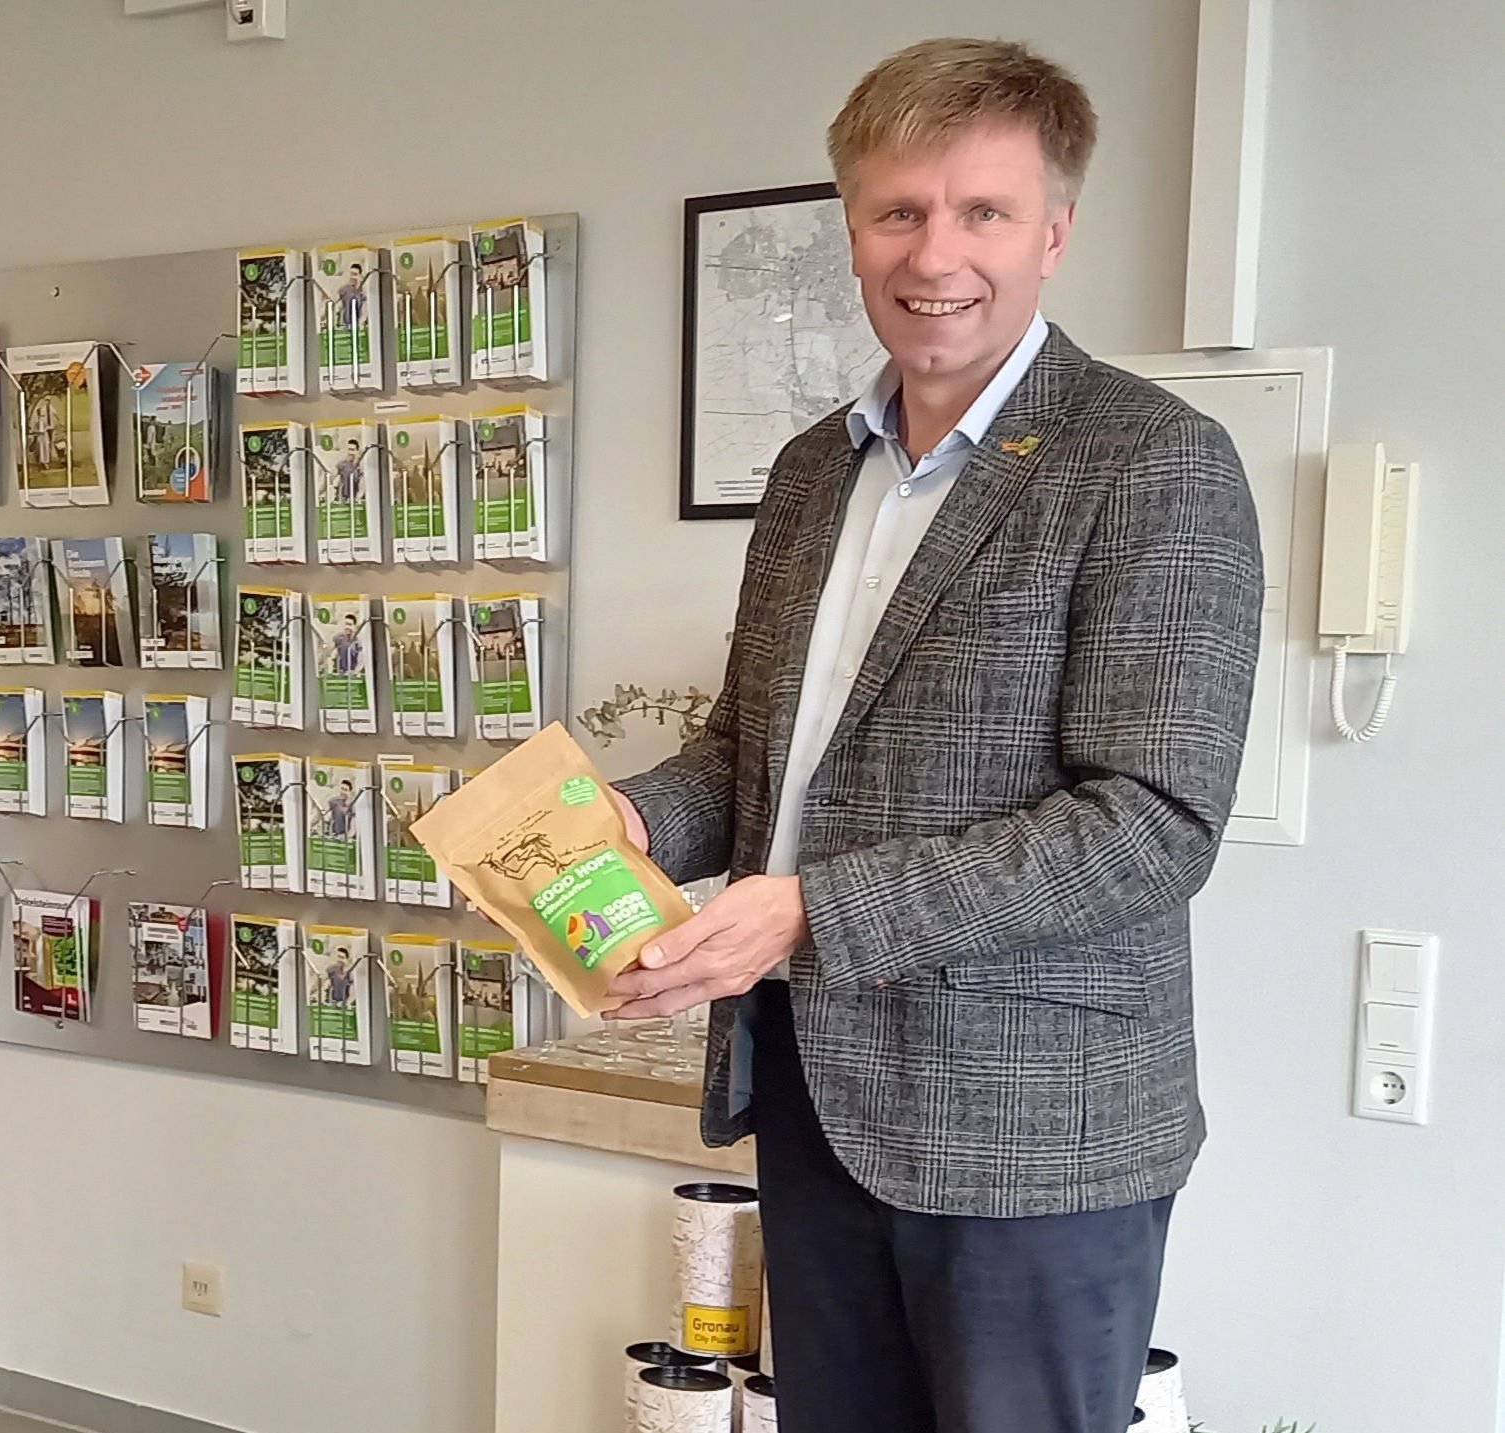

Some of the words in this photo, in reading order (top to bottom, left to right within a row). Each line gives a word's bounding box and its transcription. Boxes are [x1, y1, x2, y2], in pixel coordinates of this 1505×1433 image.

[533, 875, 575, 911] GOOD
[574, 850, 618, 878] HOPE
[602, 891, 644, 917] GOOD
[609, 899, 651, 926] HOPE
[693, 1317, 740, 1333] Gronau
